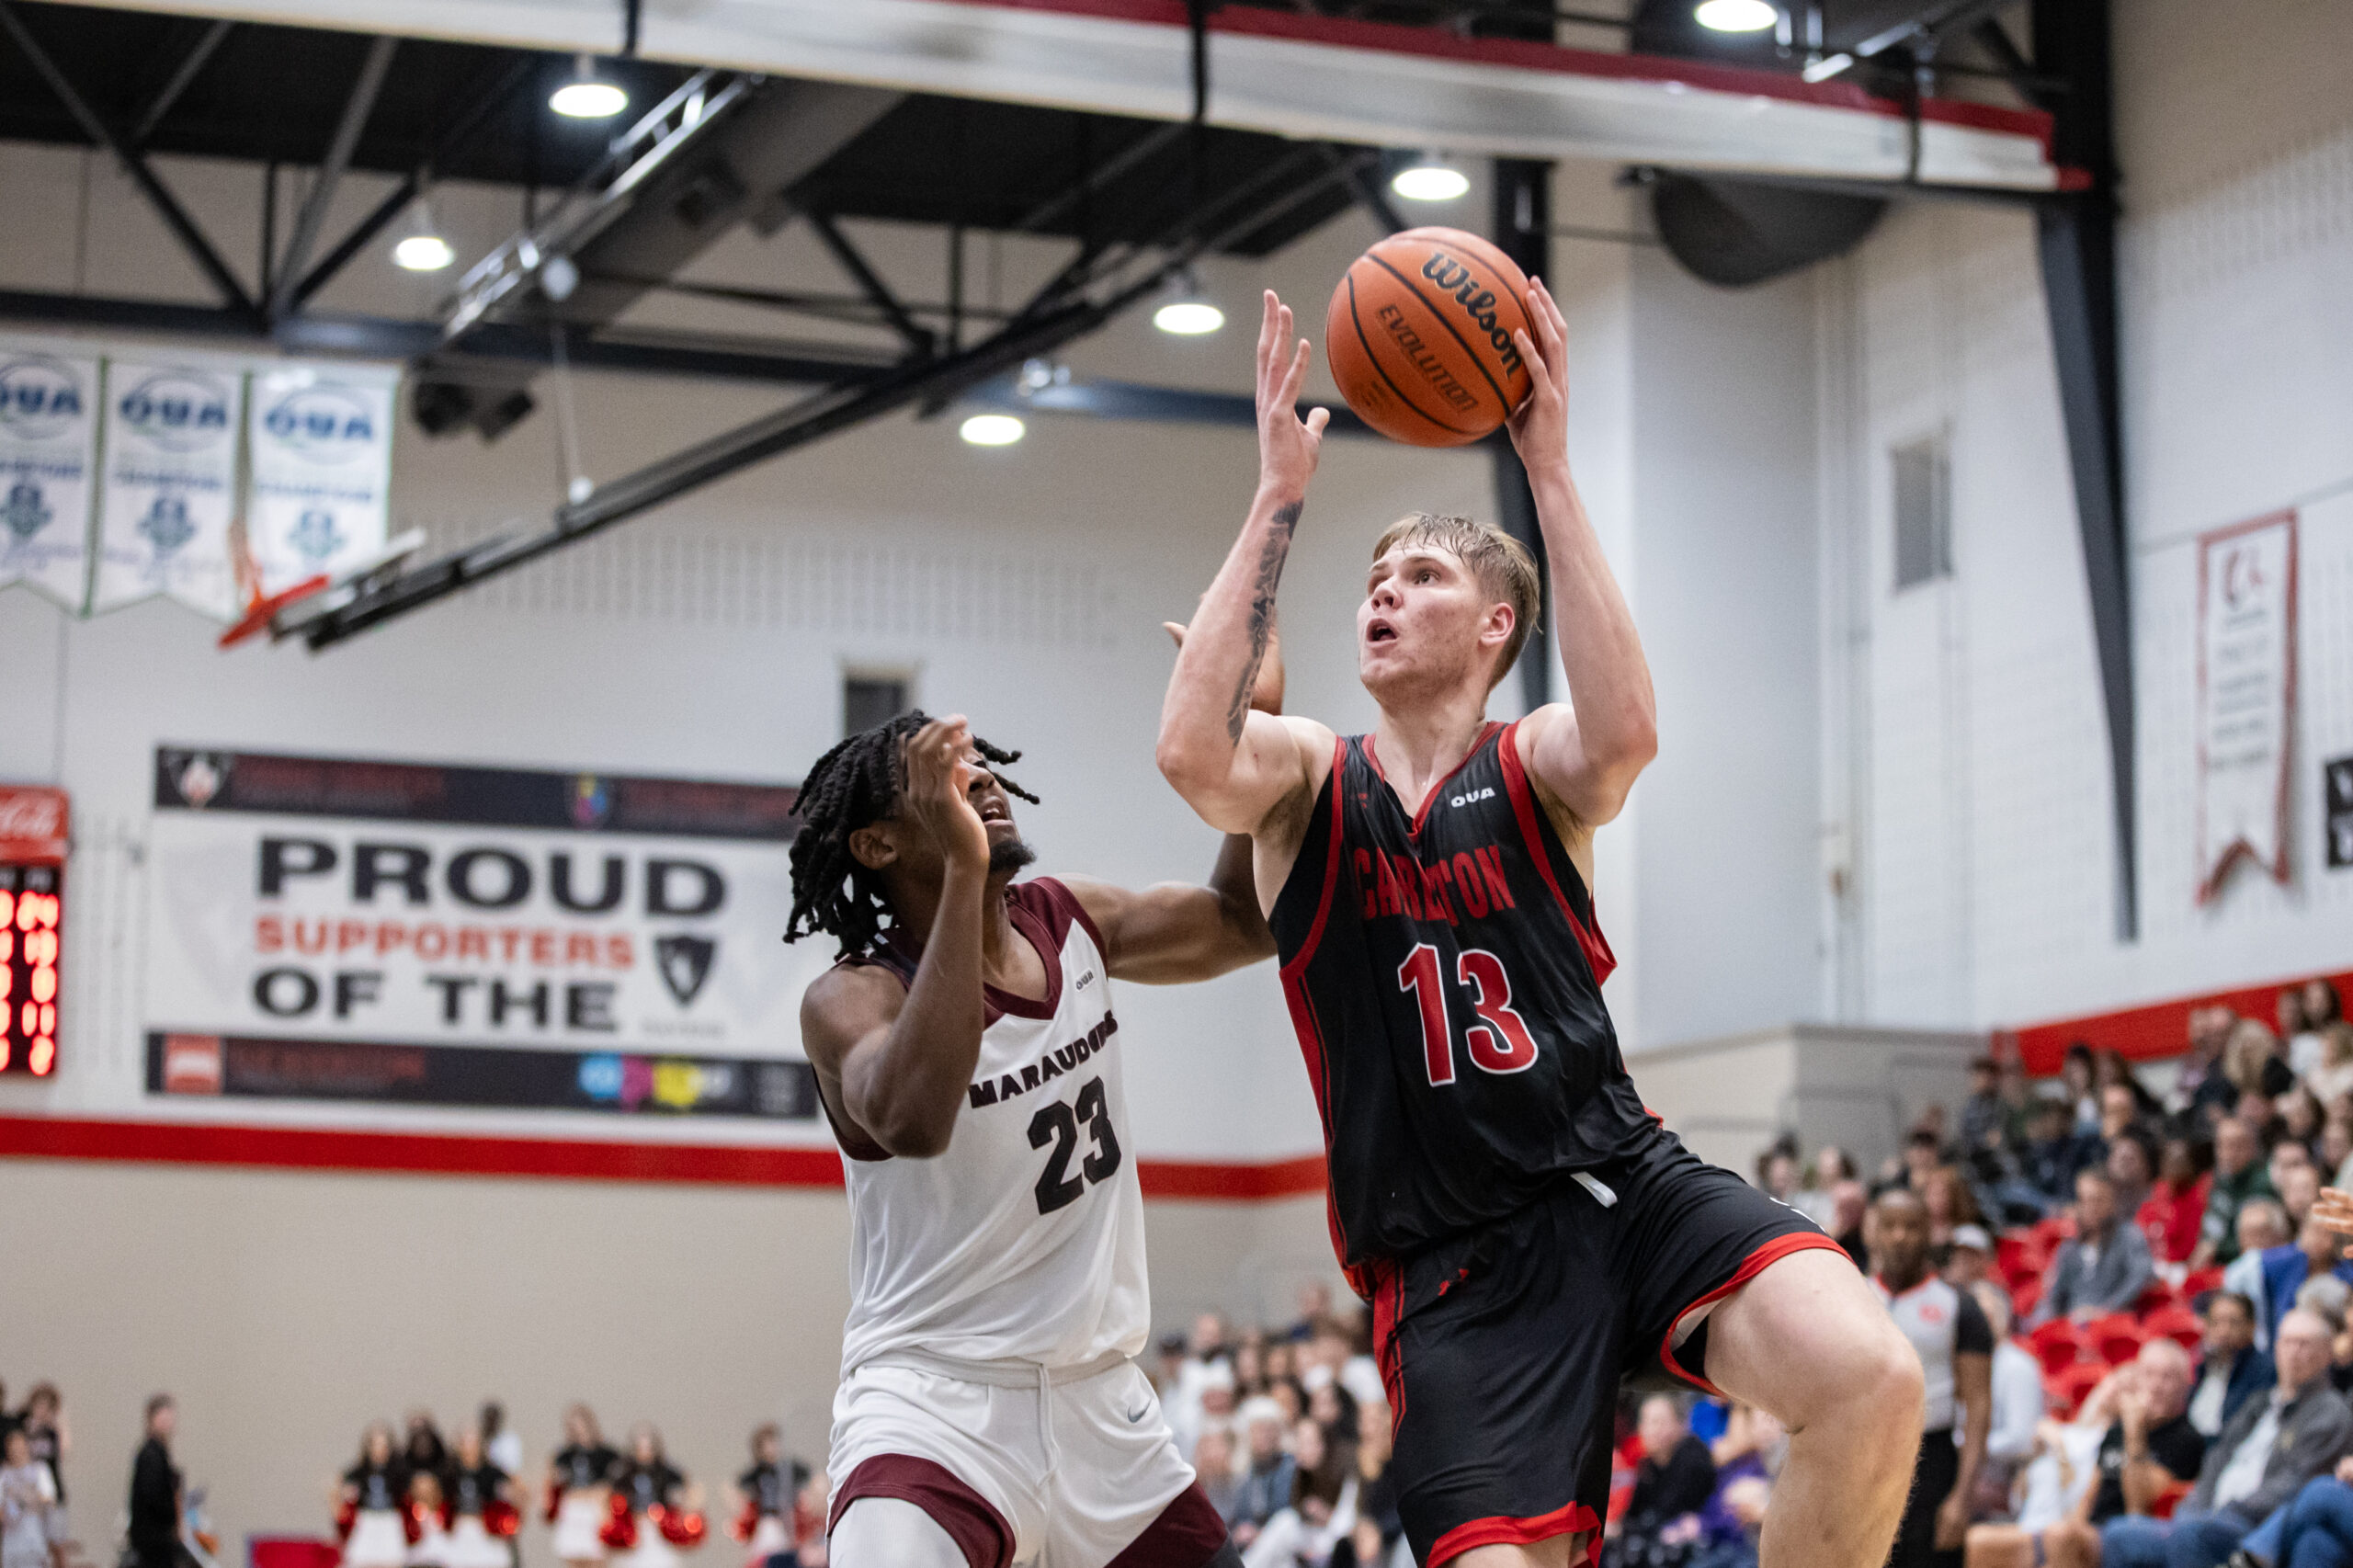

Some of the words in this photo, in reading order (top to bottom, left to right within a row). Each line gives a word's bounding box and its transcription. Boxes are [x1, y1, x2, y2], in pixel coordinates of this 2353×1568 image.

[1422, 252, 1522, 379] Wilson
[1379, 304, 1478, 412] EVOLUTION
[1450, 787, 1496, 808] OUA
[258, 837, 727, 916] PROUD
[256, 915, 635, 970] SUPPORTERS
[1076, 970, 1094, 990] OUA
[254, 968, 381, 1017] OF
[426, 974, 618, 1031] THE
[1397, 942, 1539, 1087] 13
[1027, 1075, 1121, 1216] 23
